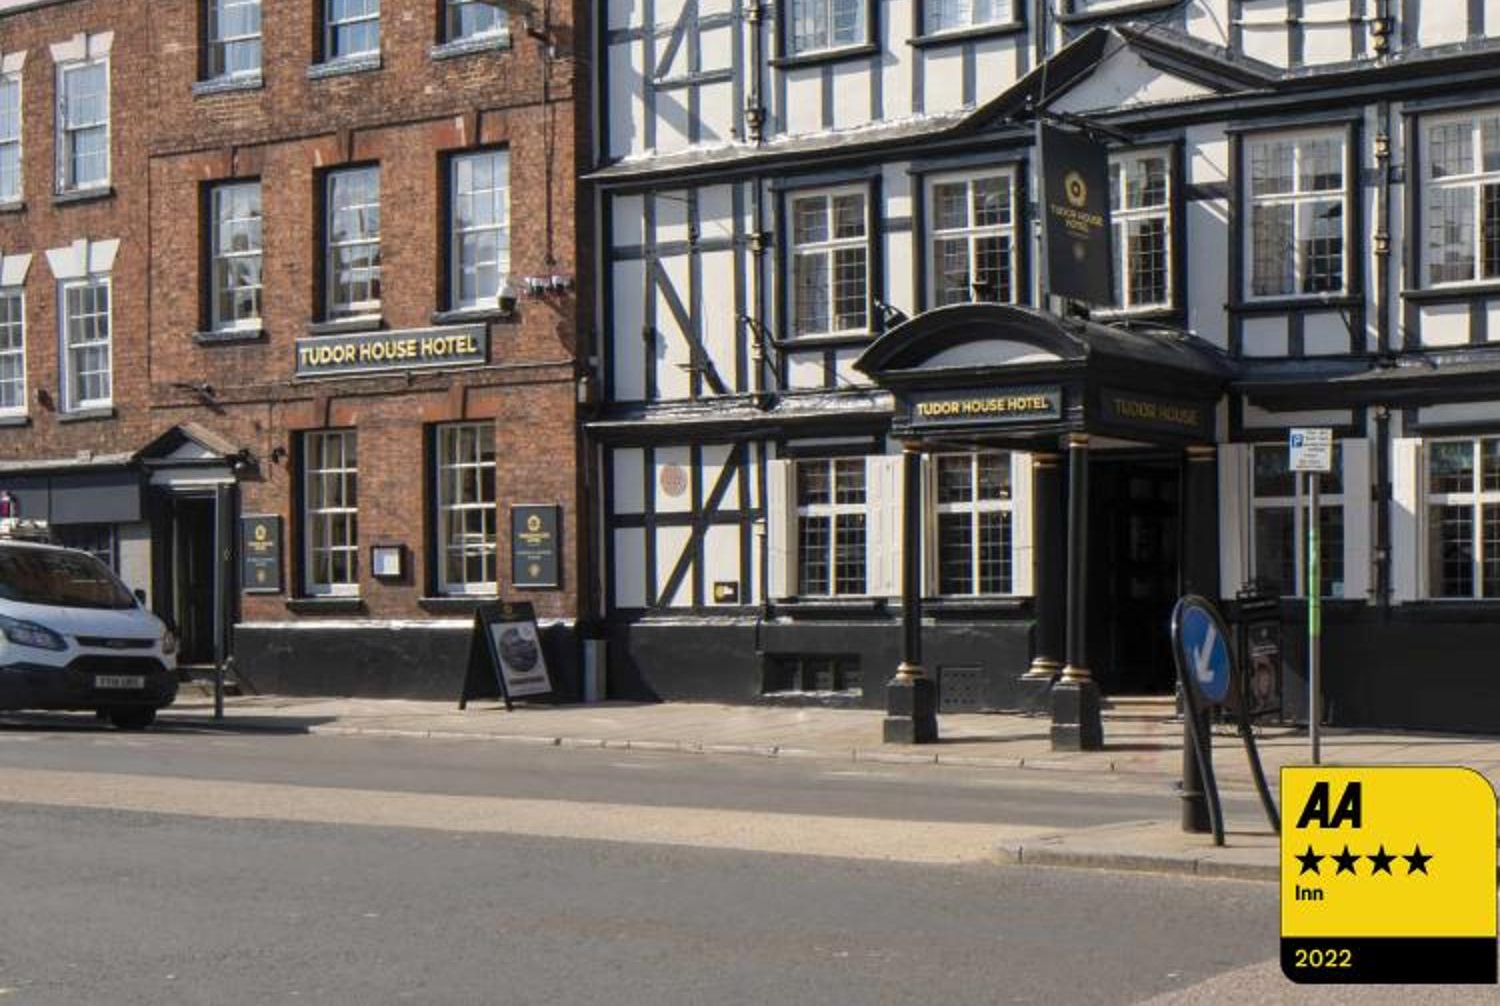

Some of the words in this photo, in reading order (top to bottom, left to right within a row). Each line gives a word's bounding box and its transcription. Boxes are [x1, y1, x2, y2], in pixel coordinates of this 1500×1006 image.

[300, 344, 355, 365] TUDOR
[359, 340, 416, 361] HOUSE
[421, 335, 477, 355] HOTEL
[917, 401, 959, 416] TUDOR
[962, 399, 1005, 414] HOUSE
[1007, 397, 1049, 411] HOTEL
[1115, 401, 1155, 418] TUDOR
[1157, 404, 1199, 425] HOUSE
